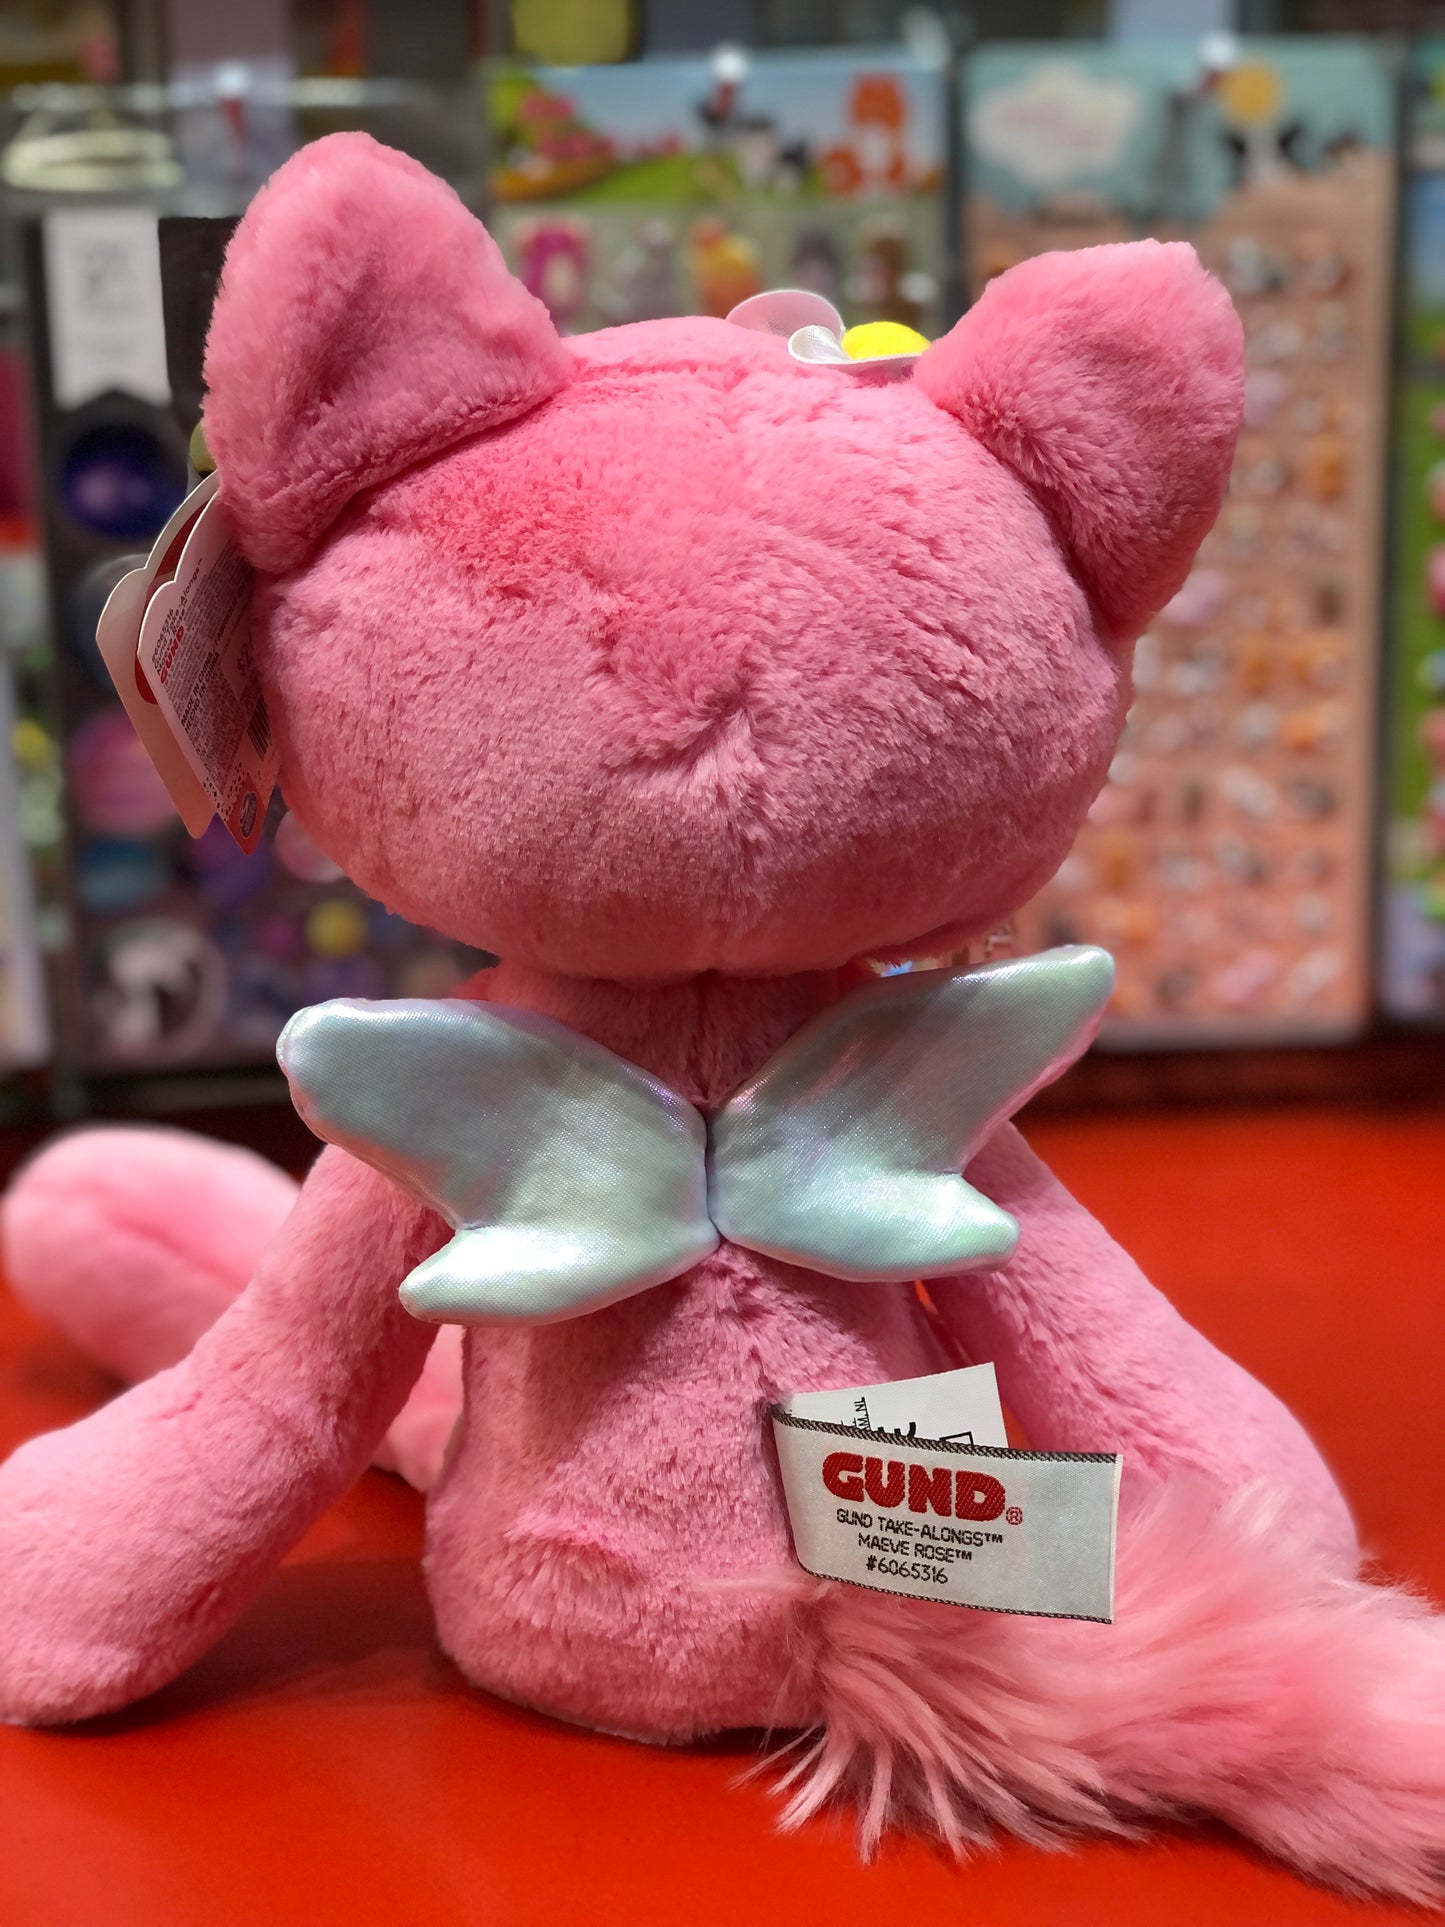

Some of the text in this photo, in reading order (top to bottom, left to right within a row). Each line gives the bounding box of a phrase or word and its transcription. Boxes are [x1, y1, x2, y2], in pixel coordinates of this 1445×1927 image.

[160, 626, 185, 684] GUND
[180, 697, 194, 727] MADE
[192, 682, 200, 697] IN
[198, 651, 214, 683] CHINA
[184, 651, 220, 734] HECHO EN CHINA
[836, 1508, 873, 1528] GUND
[858, 1532, 910, 1556] MAEVE
[866, 1554, 949, 1585] #6065316
